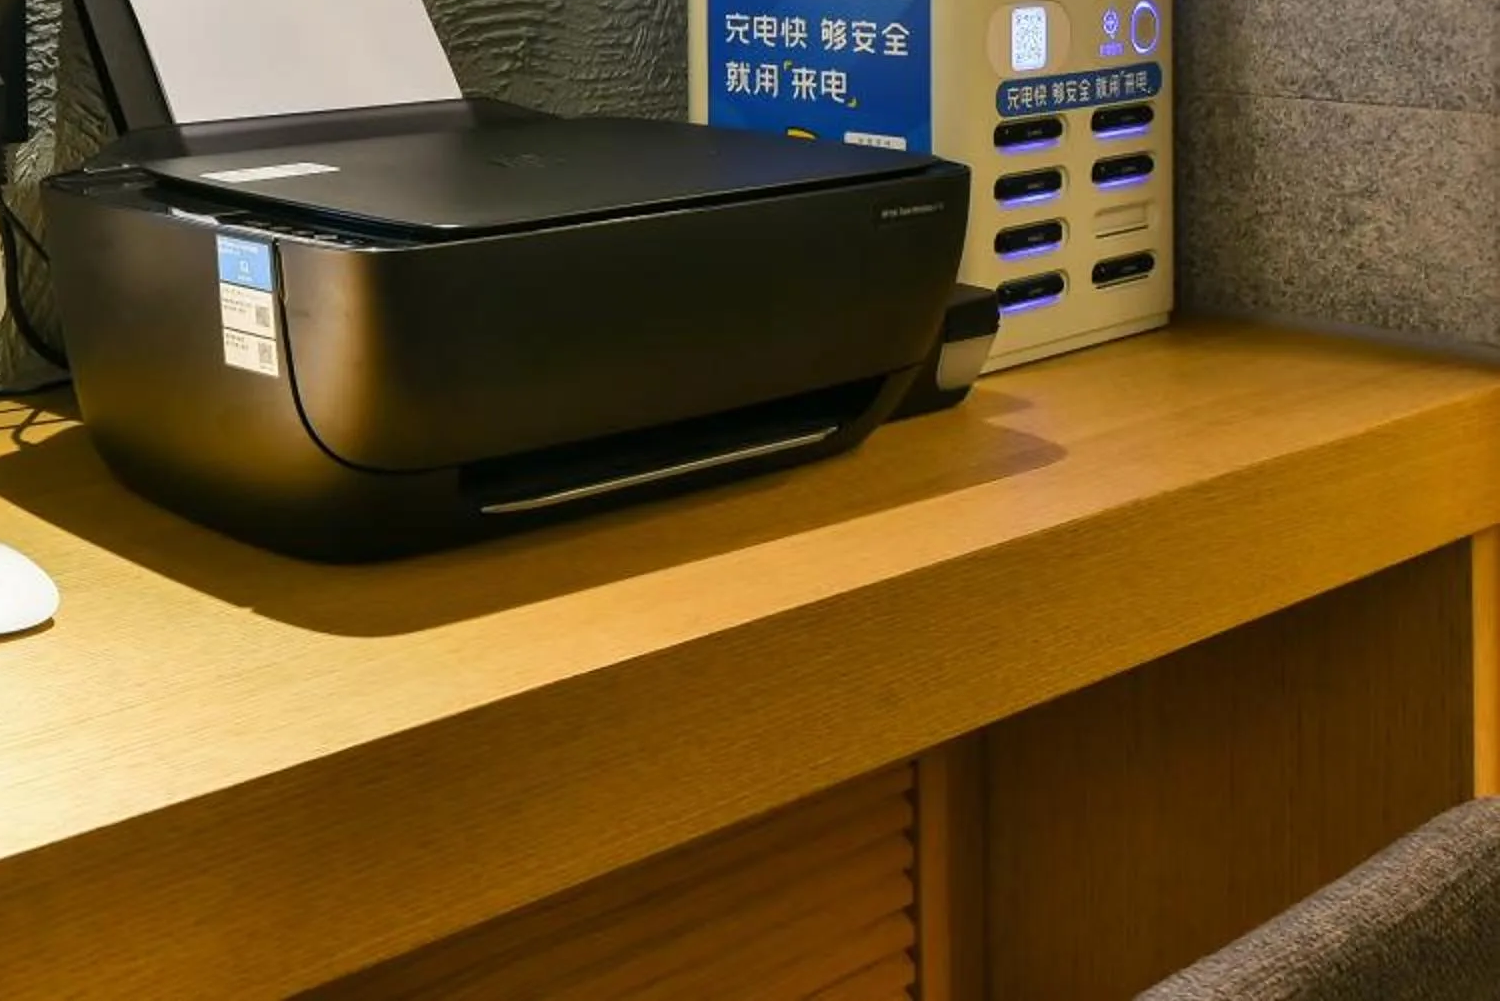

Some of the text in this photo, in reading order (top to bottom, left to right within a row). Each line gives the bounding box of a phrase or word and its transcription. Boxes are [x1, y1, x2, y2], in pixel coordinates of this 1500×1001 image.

[725, 12, 911, 56] 充电快 够安全
